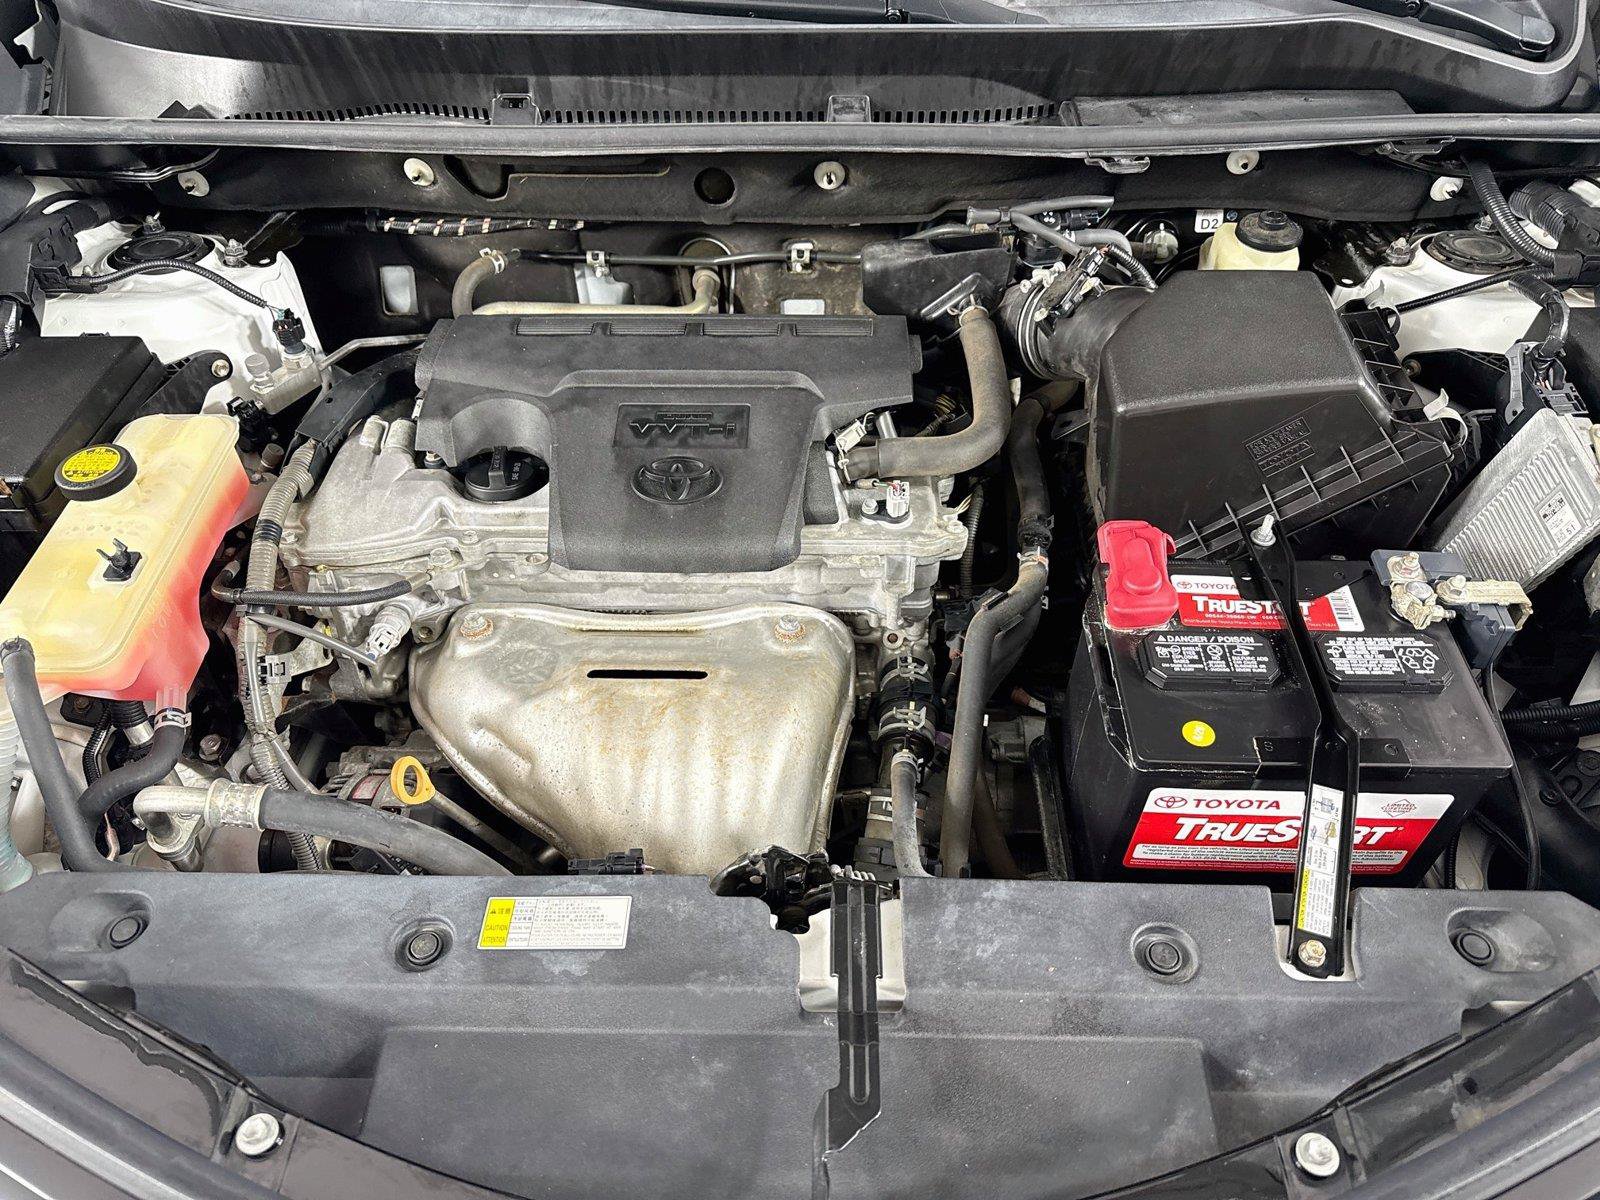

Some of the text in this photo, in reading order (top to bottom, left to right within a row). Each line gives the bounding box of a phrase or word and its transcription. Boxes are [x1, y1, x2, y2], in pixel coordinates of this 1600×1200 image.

[1201, 218, 1219, 230] D2
[1195, 582, 1237, 590] TOYOTA
[1192, 595, 1311, 616] TRUESTT
[1193, 798, 1281, 810] TOYOTA
[1174, 817, 1398, 845] TRUESRT
